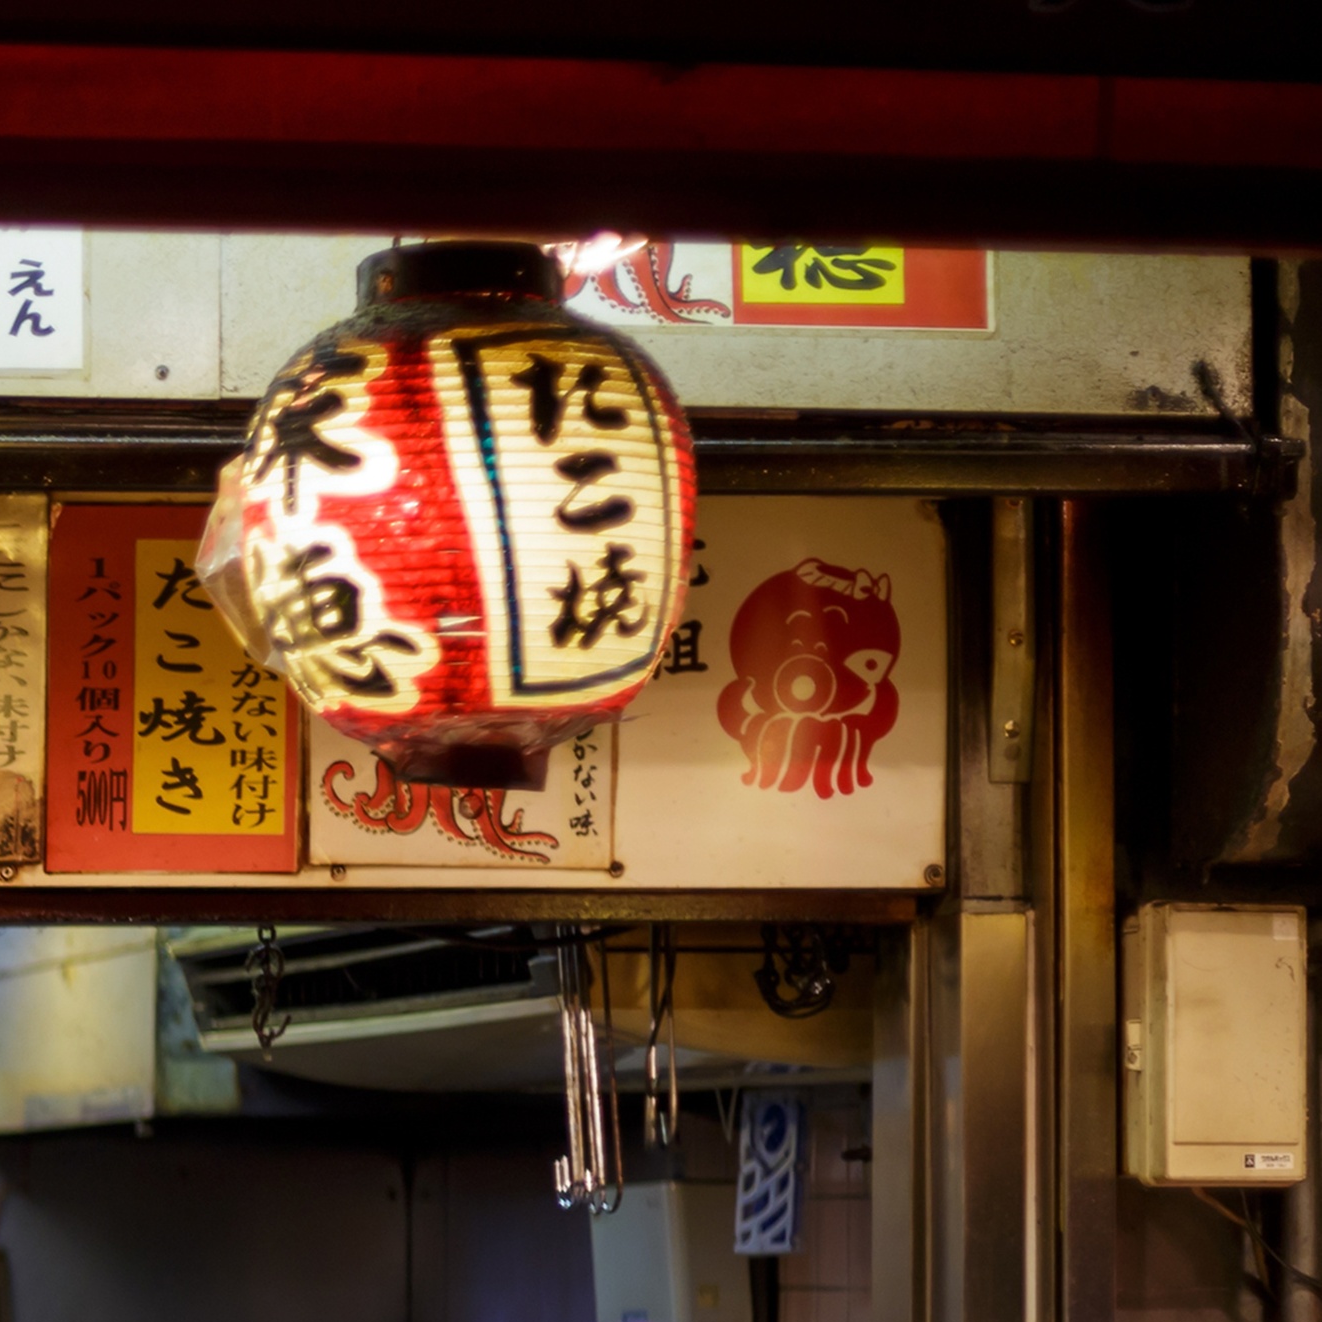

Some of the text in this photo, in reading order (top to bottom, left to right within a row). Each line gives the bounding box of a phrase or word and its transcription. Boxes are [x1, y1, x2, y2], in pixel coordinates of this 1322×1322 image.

[8, 258, 55, 338] えん
[509, 351, 654, 650] たこ焼
[138, 557, 226, 816] たこ焼き
[229, 650, 279, 828] かない味付け
[75, 768, 128, 831] 500円
